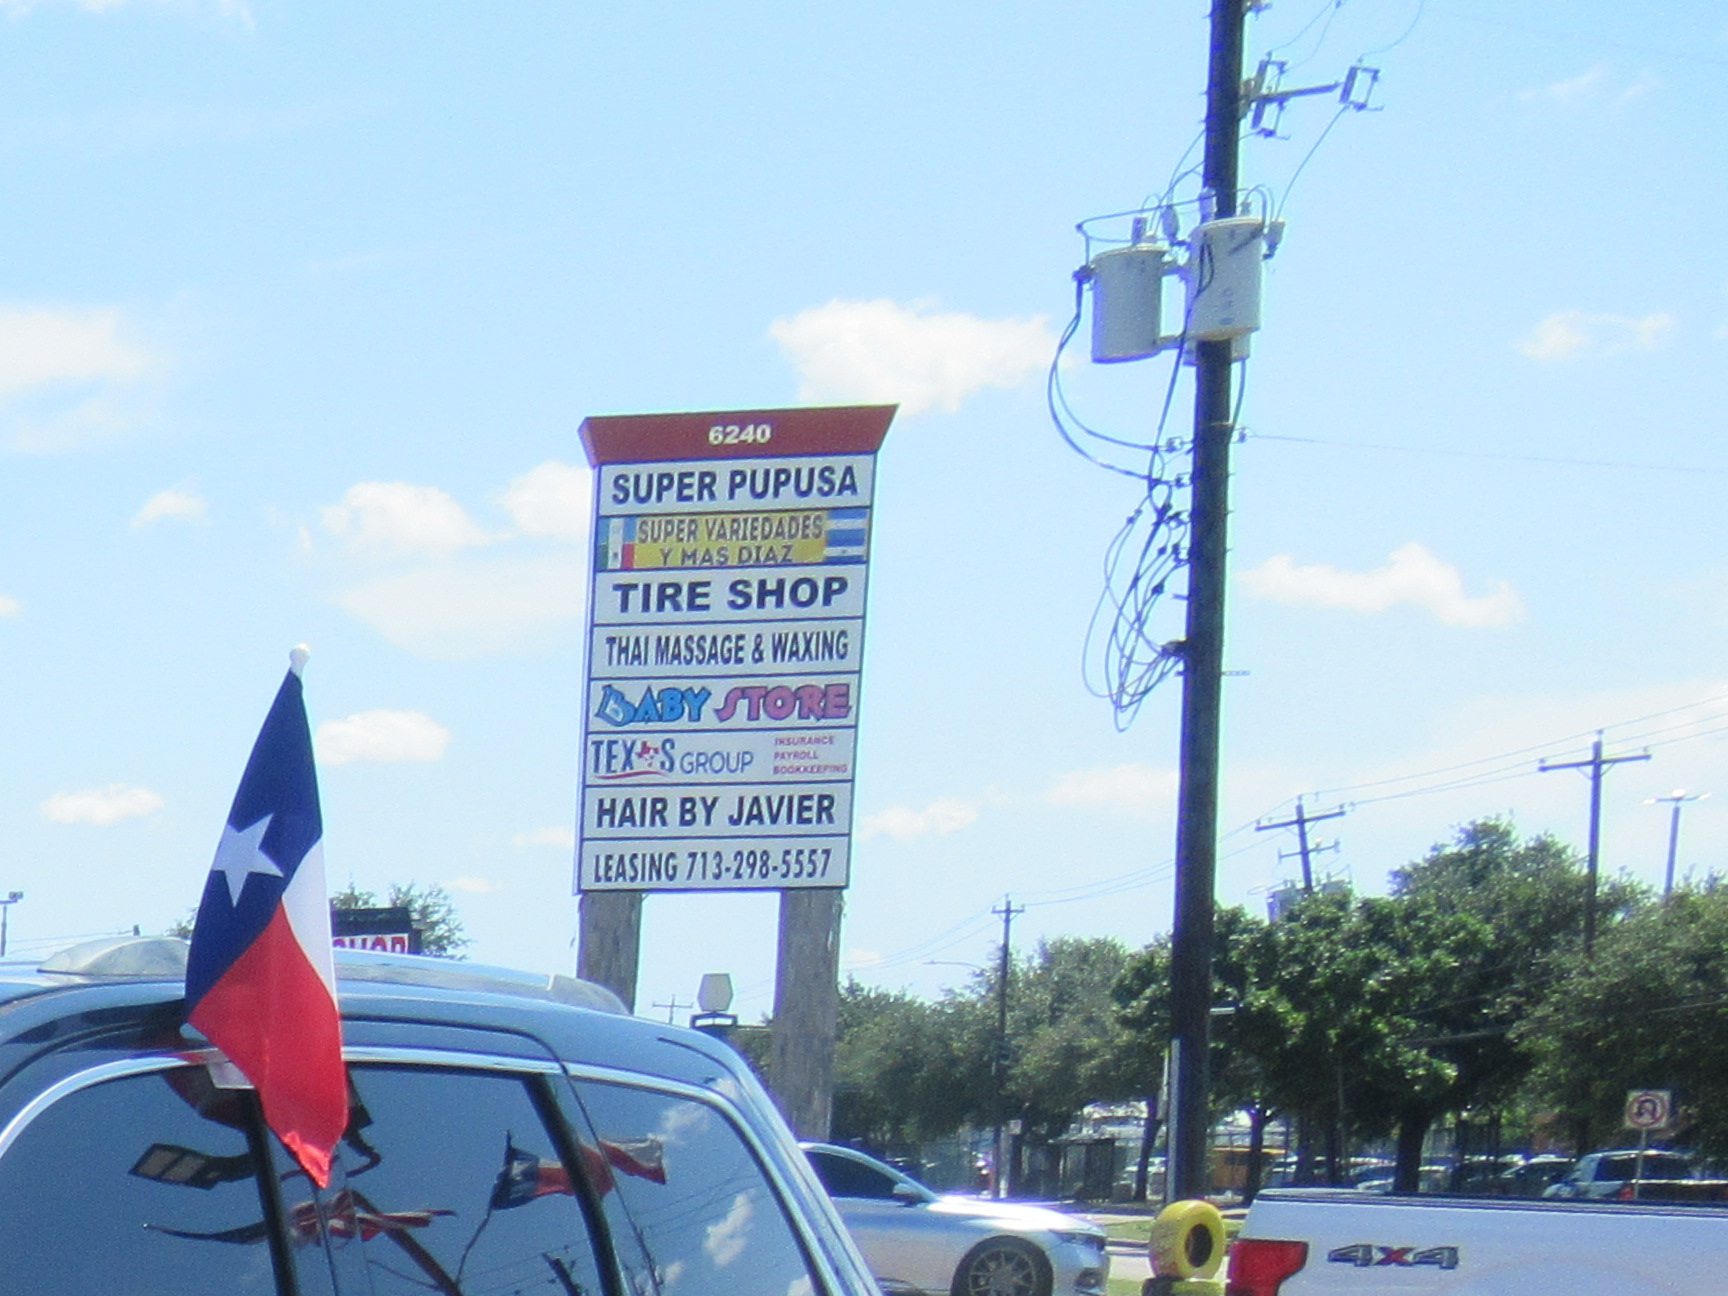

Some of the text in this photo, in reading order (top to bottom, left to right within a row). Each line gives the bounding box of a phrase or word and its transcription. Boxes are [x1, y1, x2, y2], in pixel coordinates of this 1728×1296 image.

[707, 424, 772, 446] 6240
[611, 464, 859, 505] SUPER PUPUSA
[637, 513, 824, 544] SUPER VARIEDADES
[659, 544, 794, 567] Y MAS DIAZ
[612, 576, 849, 614] TIRE SHOP
[605, 629, 849, 667] THAI MASSAGE & WAXING
[594, 682, 853, 727] BABY STORE
[591, 737, 755, 775] TEXS GROUP
[596, 793, 836, 829] HAIR BY JAVIER
[594, 848, 833, 883] LEASING 713-298-5557
